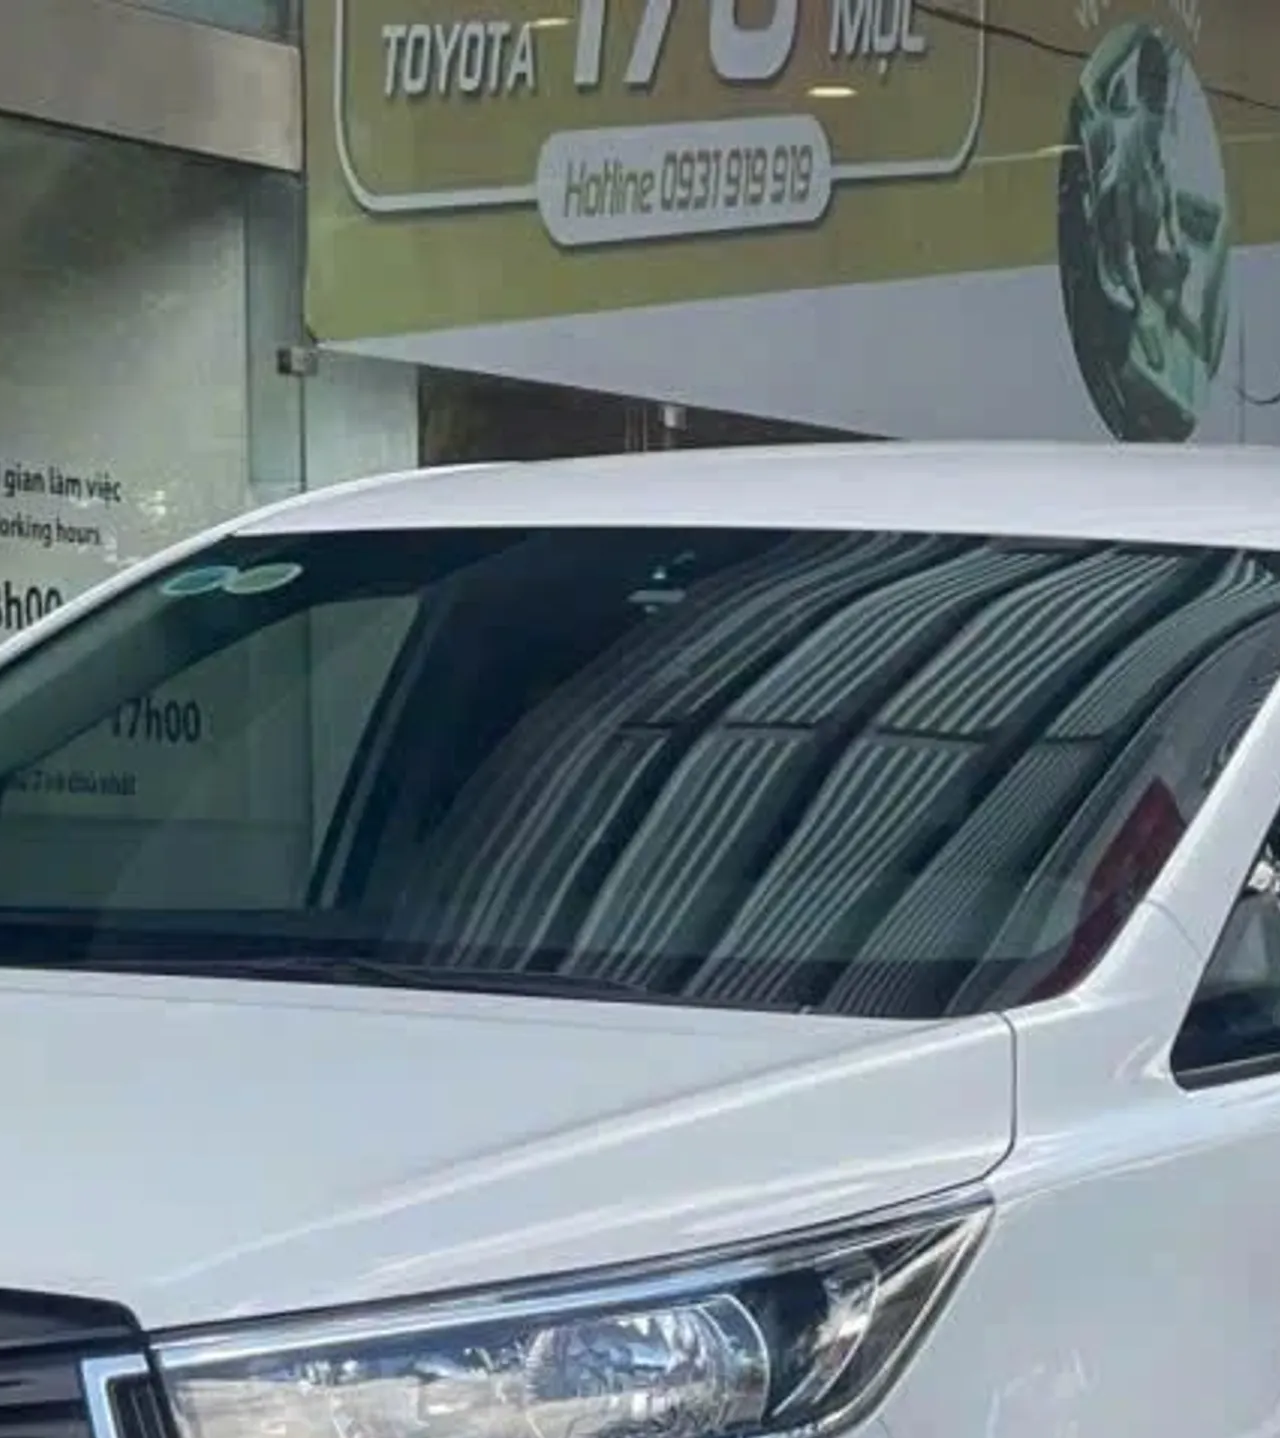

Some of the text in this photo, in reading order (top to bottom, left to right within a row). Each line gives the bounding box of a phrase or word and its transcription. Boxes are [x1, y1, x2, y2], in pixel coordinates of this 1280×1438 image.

[381, 21, 535, 95] TOYOTA
[563, 143, 813, 218] Hotline 0931 919 919
[4, 463, 46, 498] gian
[56, 514, 101, 546] hours
